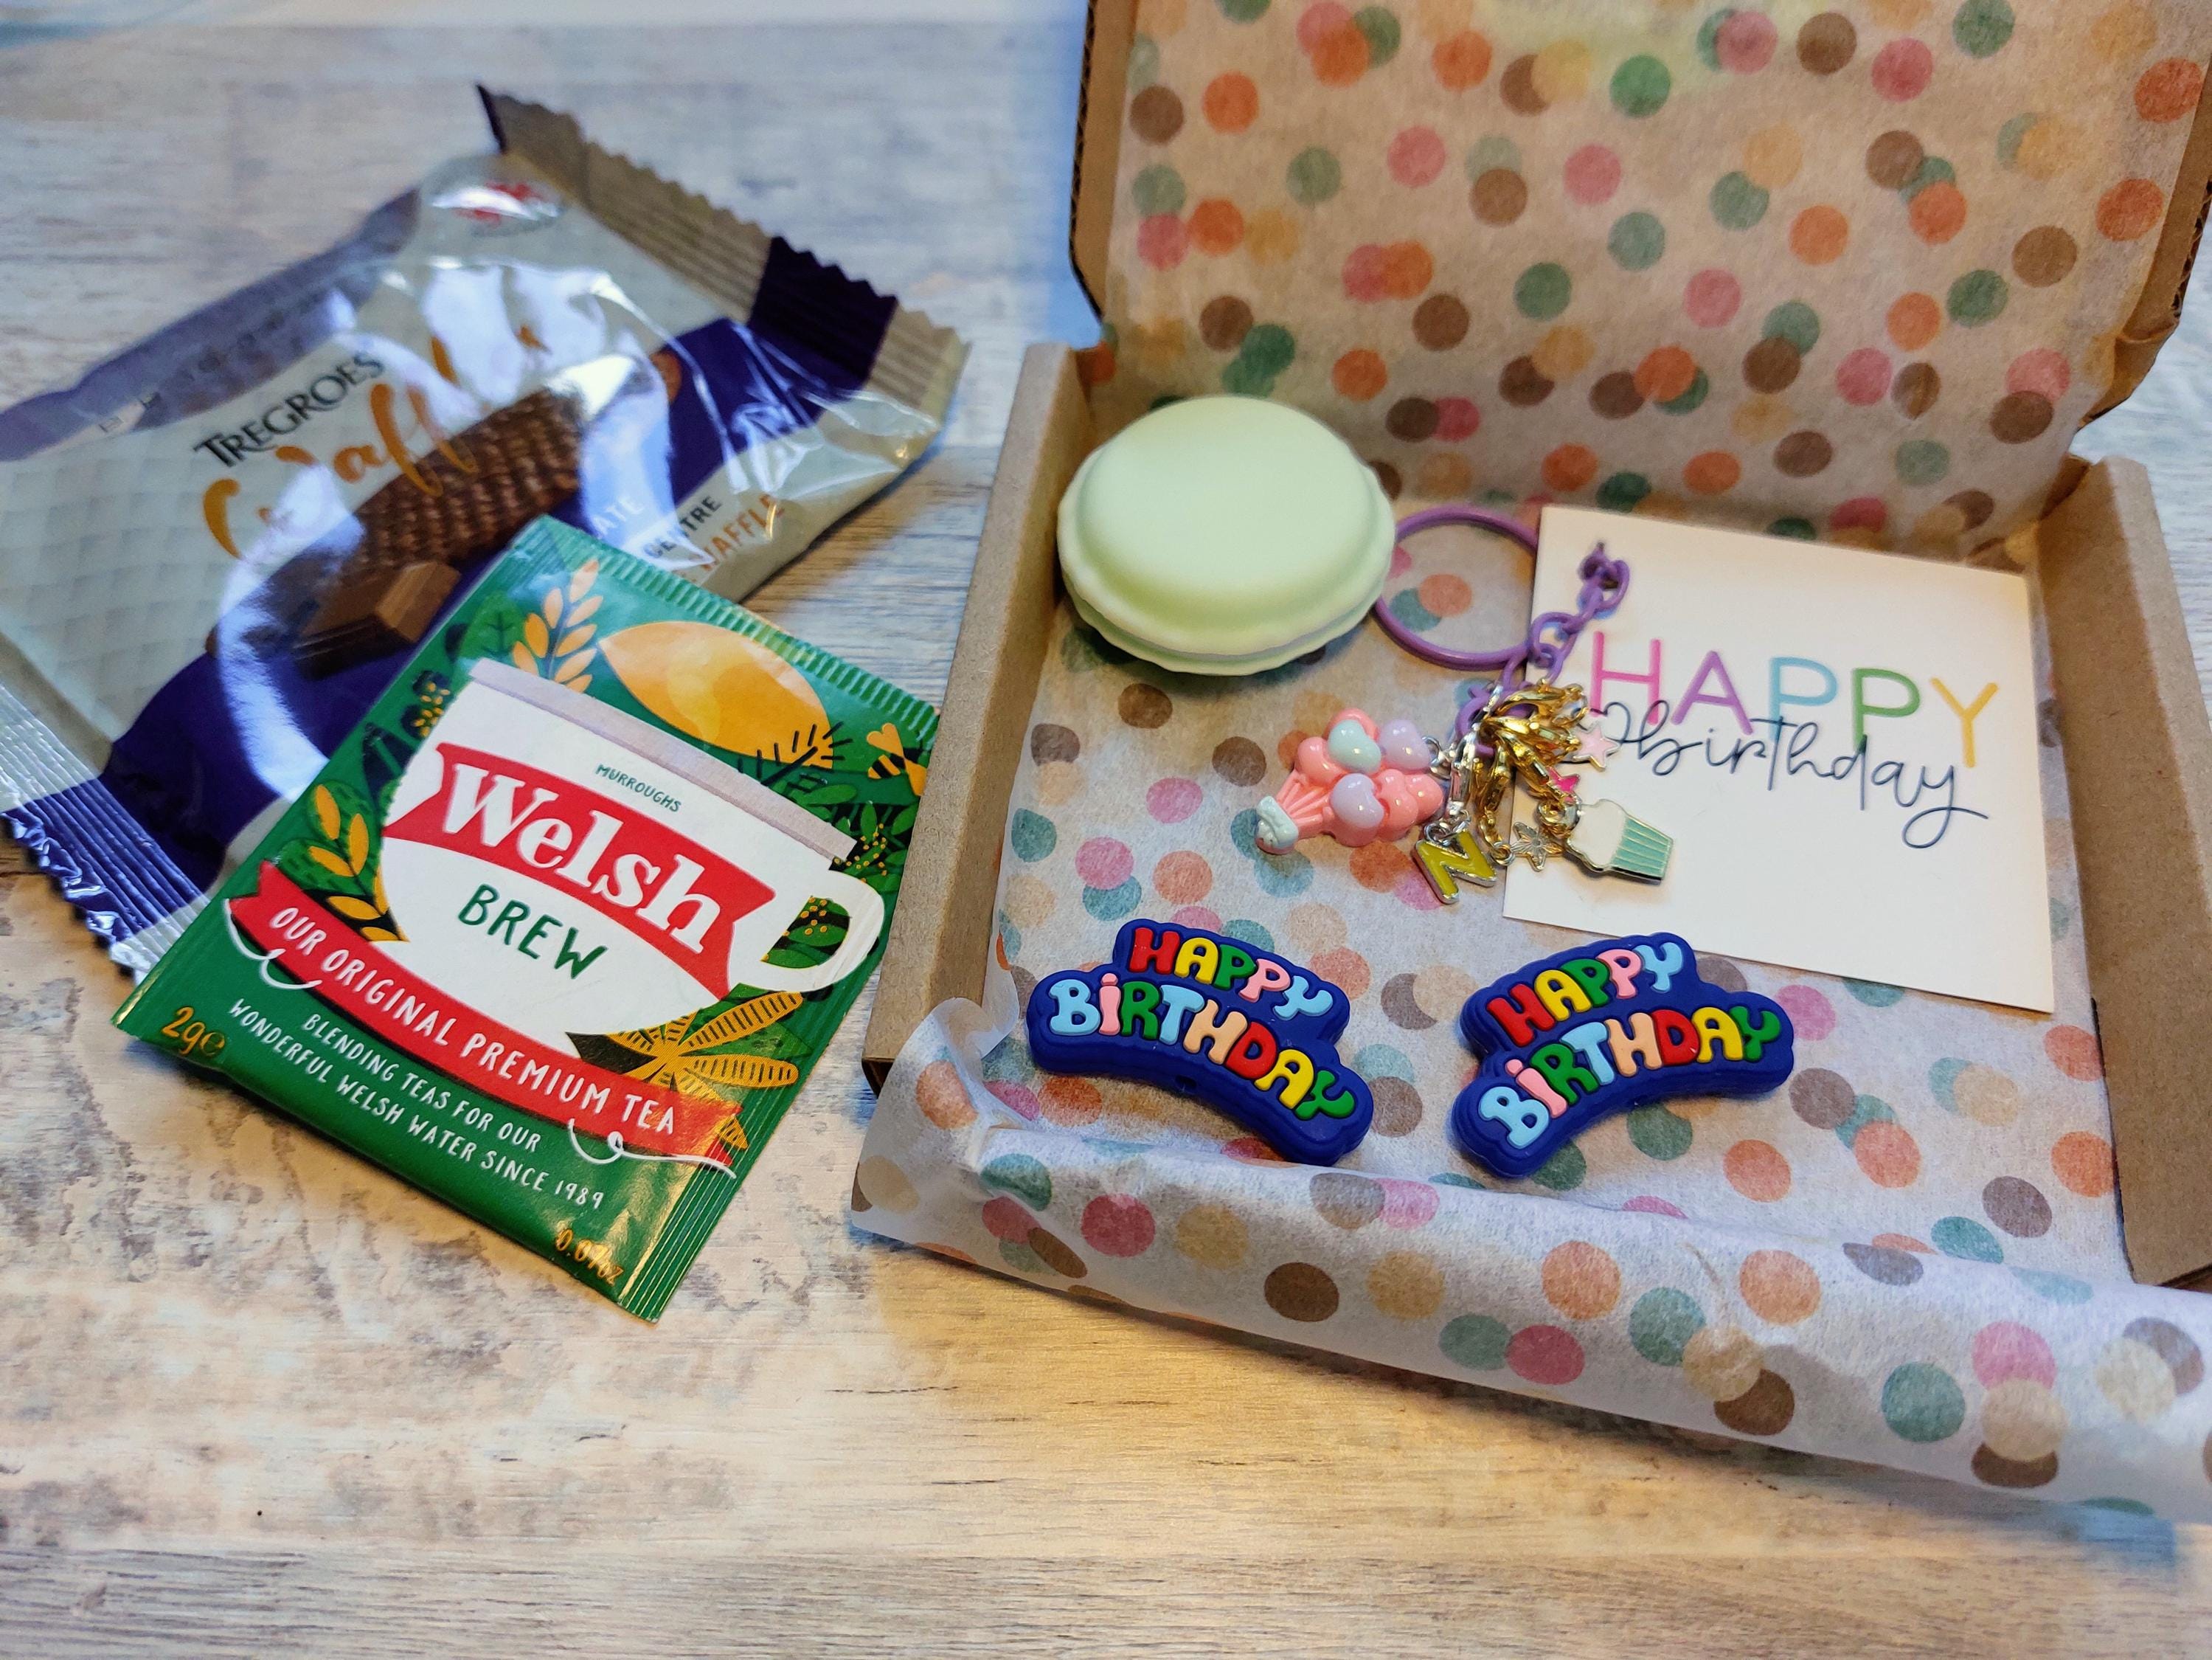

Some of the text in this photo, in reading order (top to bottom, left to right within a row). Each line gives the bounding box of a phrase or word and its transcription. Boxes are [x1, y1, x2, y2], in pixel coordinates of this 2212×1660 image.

[193, 350, 386, 468] TREGROES
[643, 495, 722, 558] CETRE
[1589, 631, 2000, 768] HAPPY
[595, 764, 682, 812] MURROUGHS
[1602, 700, 1988, 848] birthday
[442, 764, 721, 954] Welsh
[457, 884, 609, 980] BREW
[1128, 927, 1333, 1020] HAPPY
[1487, 941, 1684, 1047] HAPPY
[270, 907, 675, 1135] OUR ORIGINAL PREMIUM TEA
[302, 1014, 541, 1152] BLENDING TEAS FOR OUR
[228, 998, 605, 1209] WONDERFUL WELSH WATER SINCE 1989
